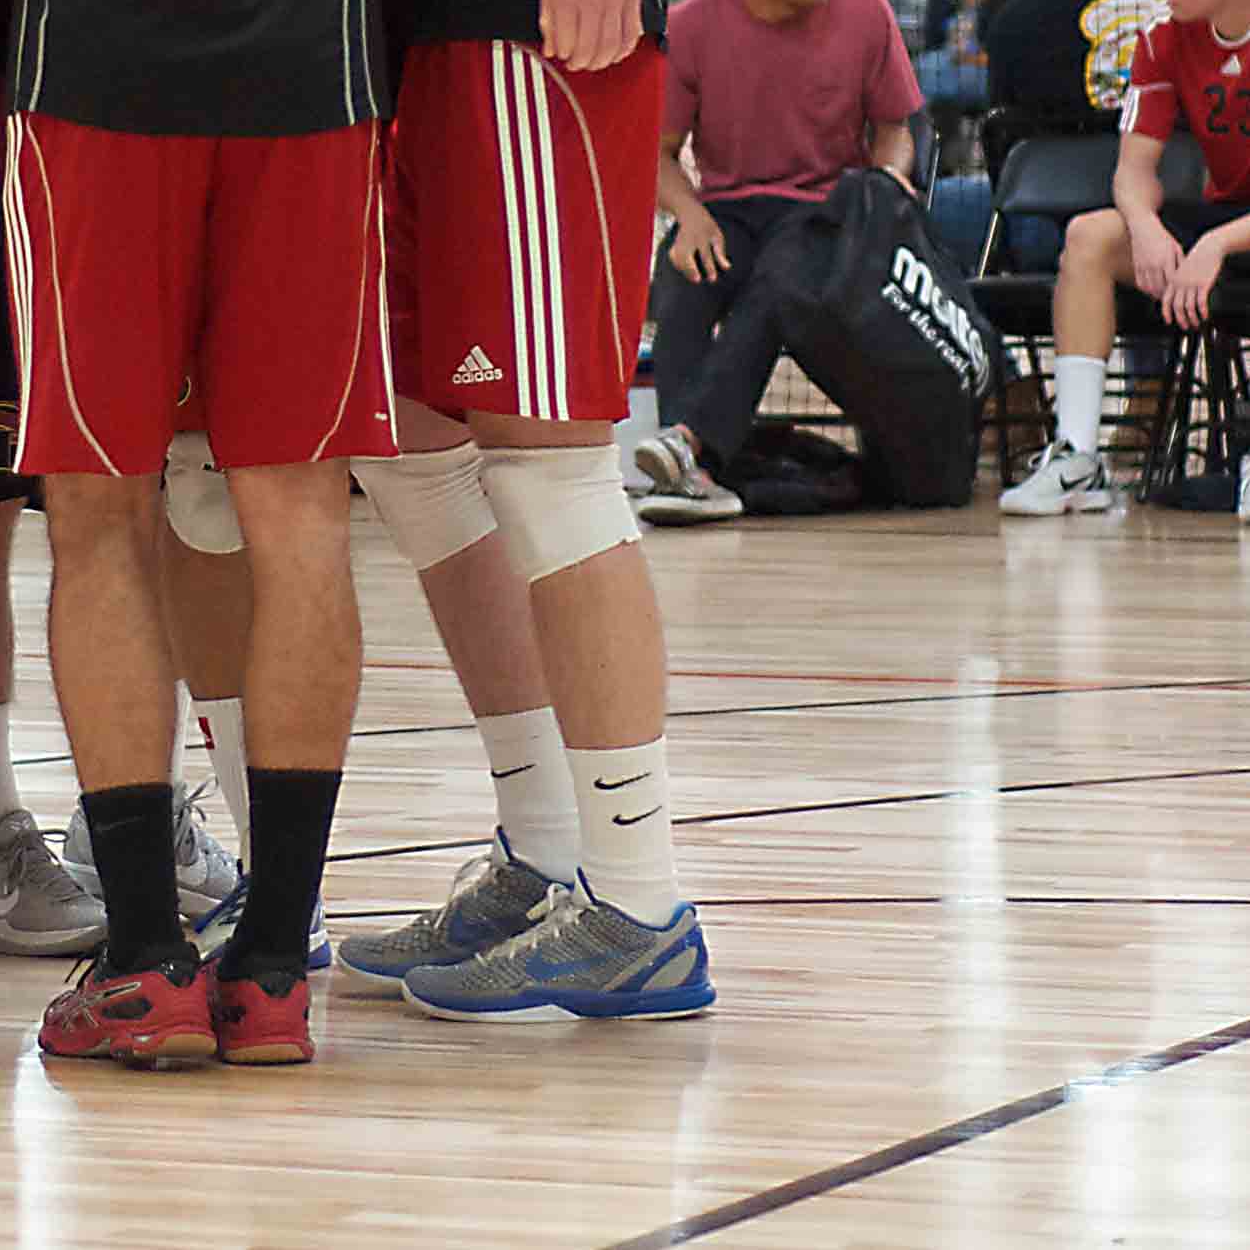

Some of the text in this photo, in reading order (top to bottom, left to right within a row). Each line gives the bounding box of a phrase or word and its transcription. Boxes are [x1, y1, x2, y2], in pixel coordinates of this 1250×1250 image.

[882, 283, 911, 312] For
[909, 310, 938, 341] the
[452, 368, 503, 385] adidas
